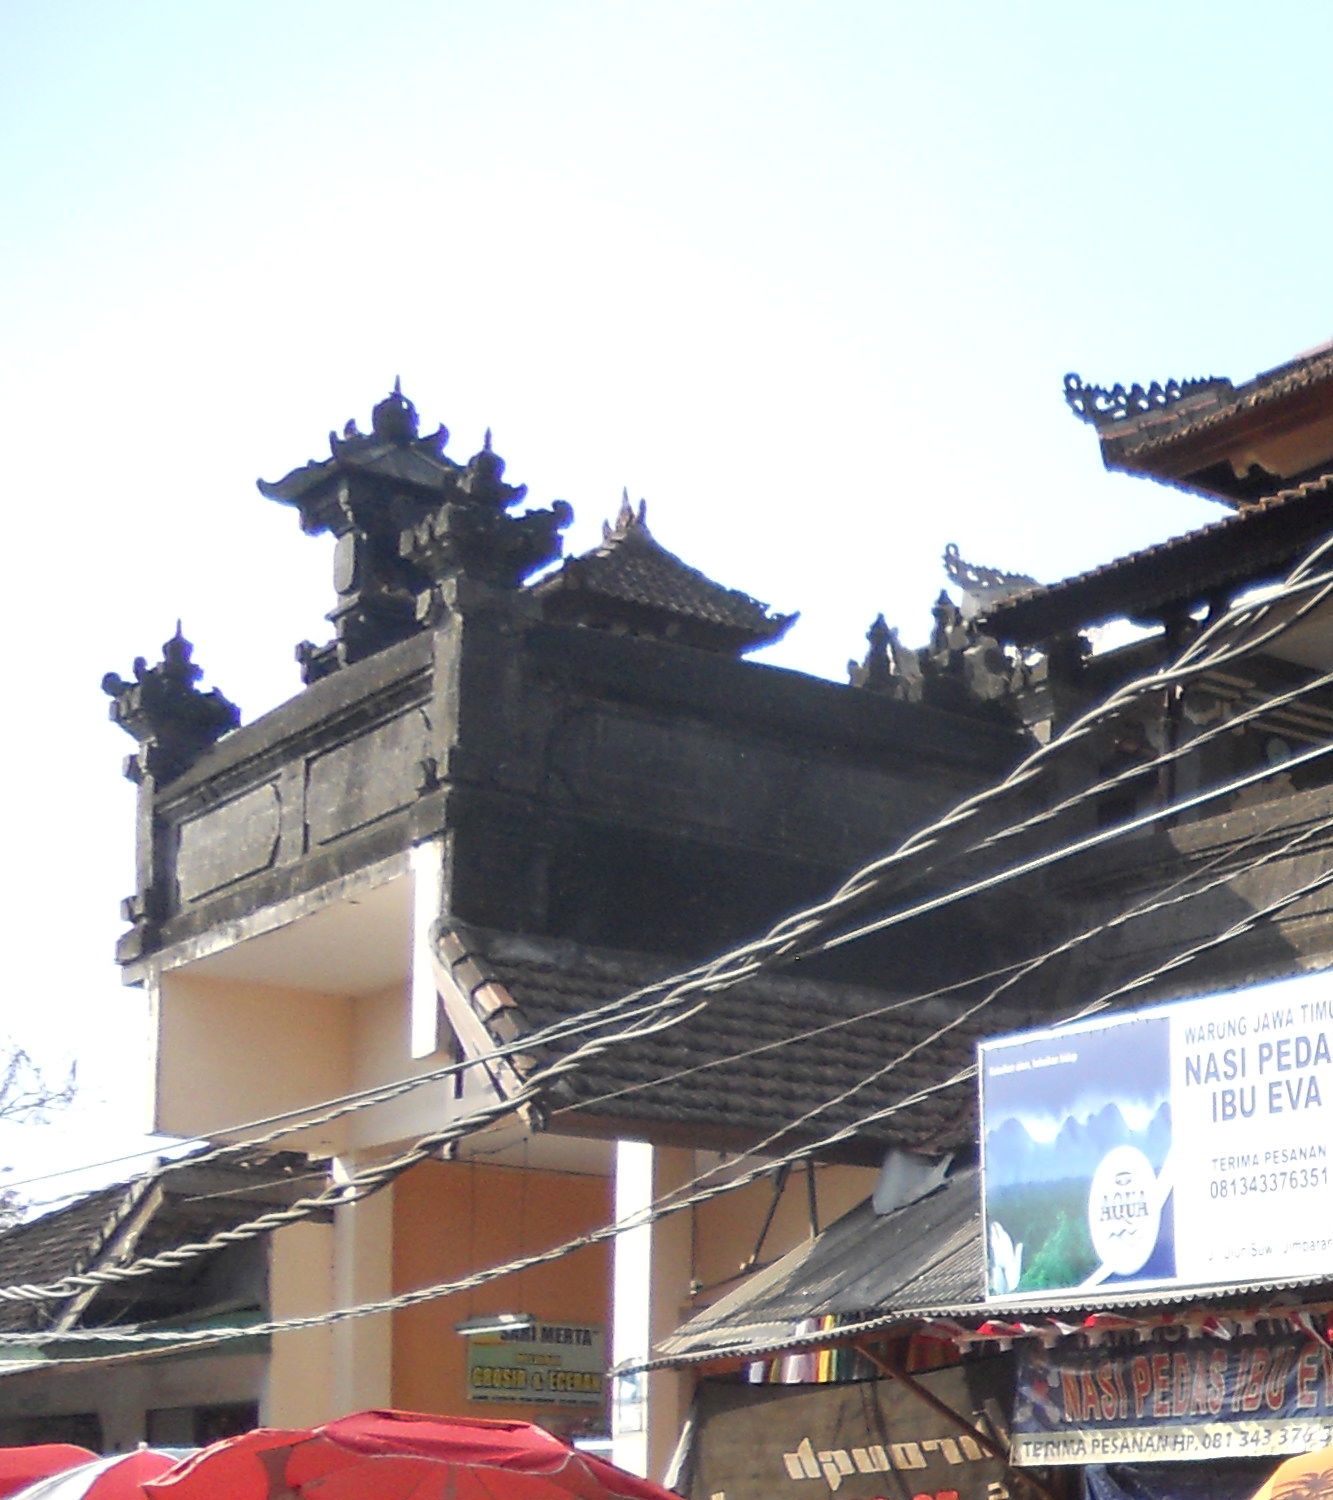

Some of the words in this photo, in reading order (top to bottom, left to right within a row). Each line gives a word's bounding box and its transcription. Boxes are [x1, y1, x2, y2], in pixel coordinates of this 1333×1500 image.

[1184, 1016, 1247, 1045] WARUNG
[1253, 1008, 1294, 1033] JAWA
[1185, 1047, 1246, 1086] NASI
[1212, 1085, 1256, 1122] IBU
[1268, 1075, 1322, 1114] EVA
[1212, 1154, 1259, 1171] TERIMA
[1265, 1145, 1326, 1164] PESANAN
[1210, 1167, 1328, 1199] 081343376351
[1099, 1190, 1149, 1224] AQUA
[1062, 1364, 1127, 1422] NASI
[1133, 1350, 1229, 1418] PEDAS
[1233, 1345, 1290, 1412] IBU
[1023, 1438, 1087, 1458] TERIMA
[1090, 1434, 1169, 1455] PESANAN
[1172, 1433, 1198, 1451] HP.
[1202, 1432, 1232, 1450] 081
[1238, 1429, 1272, 1447] 343
